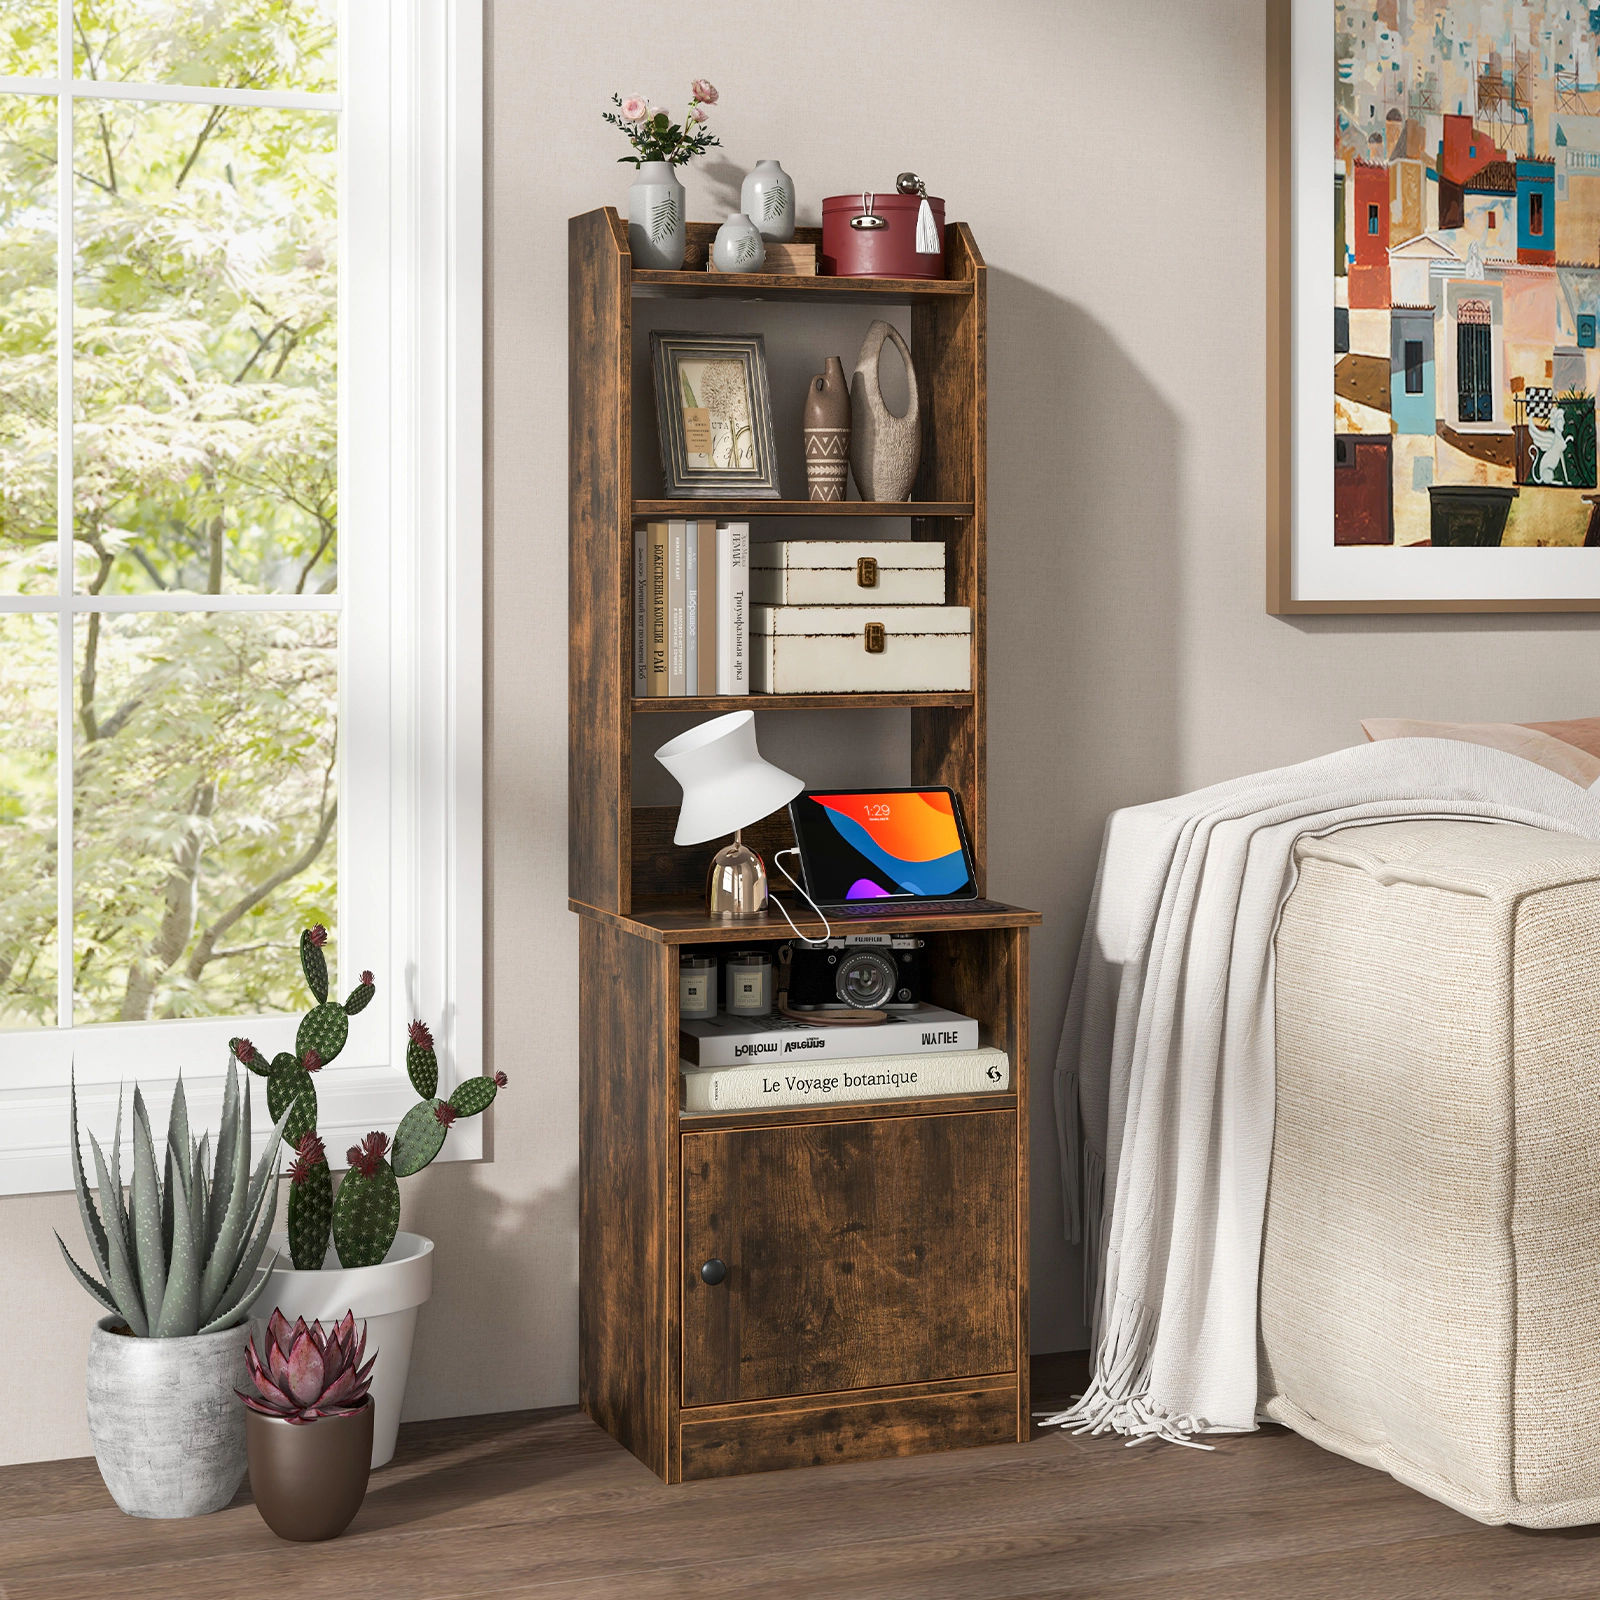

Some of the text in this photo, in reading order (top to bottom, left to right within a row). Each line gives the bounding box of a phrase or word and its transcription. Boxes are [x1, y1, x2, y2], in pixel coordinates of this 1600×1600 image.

[638, 579, 646, 613] Уличный
[653, 544, 664, 643] БОЖЕСТВЕННАЯ КОМЕДИЯ
[689, 589, 697, 636] Избранное
[638, 629, 644, 639] по
[734, 590, 745, 681] Триумфальная арка
[638, 665, 646, 679] Боб
[653, 650, 667, 673] РАЙ
[864, 804, 890, 816] 1:29
[762, 1069, 918, 1094] Le Voyage botanique
